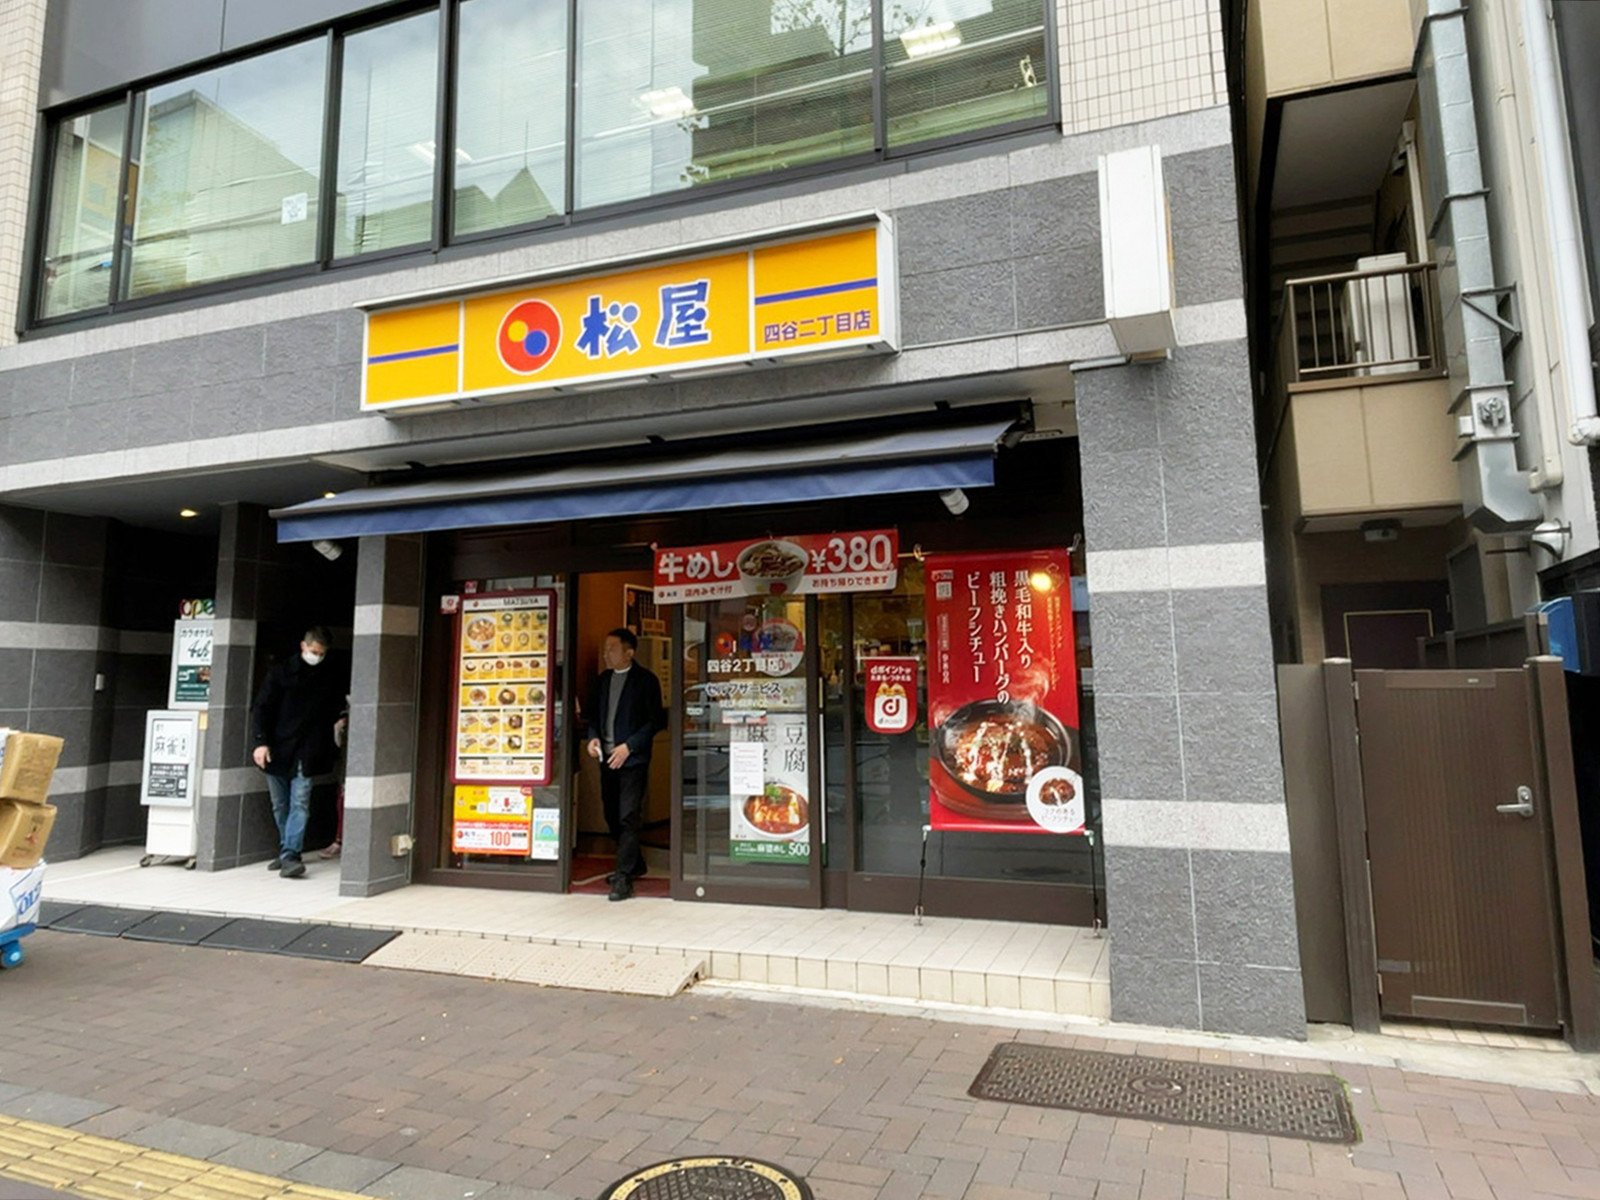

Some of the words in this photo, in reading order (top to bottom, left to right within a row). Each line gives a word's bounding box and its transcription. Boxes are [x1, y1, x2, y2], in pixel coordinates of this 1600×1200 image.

[574, 280, 710, 358] 松屋
[763, 310, 872, 343] 四谷二丁目店
[658, 550, 735, 583] 牛めし
[810, 534, 892, 573] ¥380
[811, 574, 889, 588] お持ち帰りできます
[967, 571, 986, 683] ビーフシチュー
[1013, 569, 1034, 669] 黒毛和牛入り
[989, 571, 1011, 704] 粗挽きハンバーグの
[490, 831, 511, 846] 100
[788, 842, 811, 857] 500
